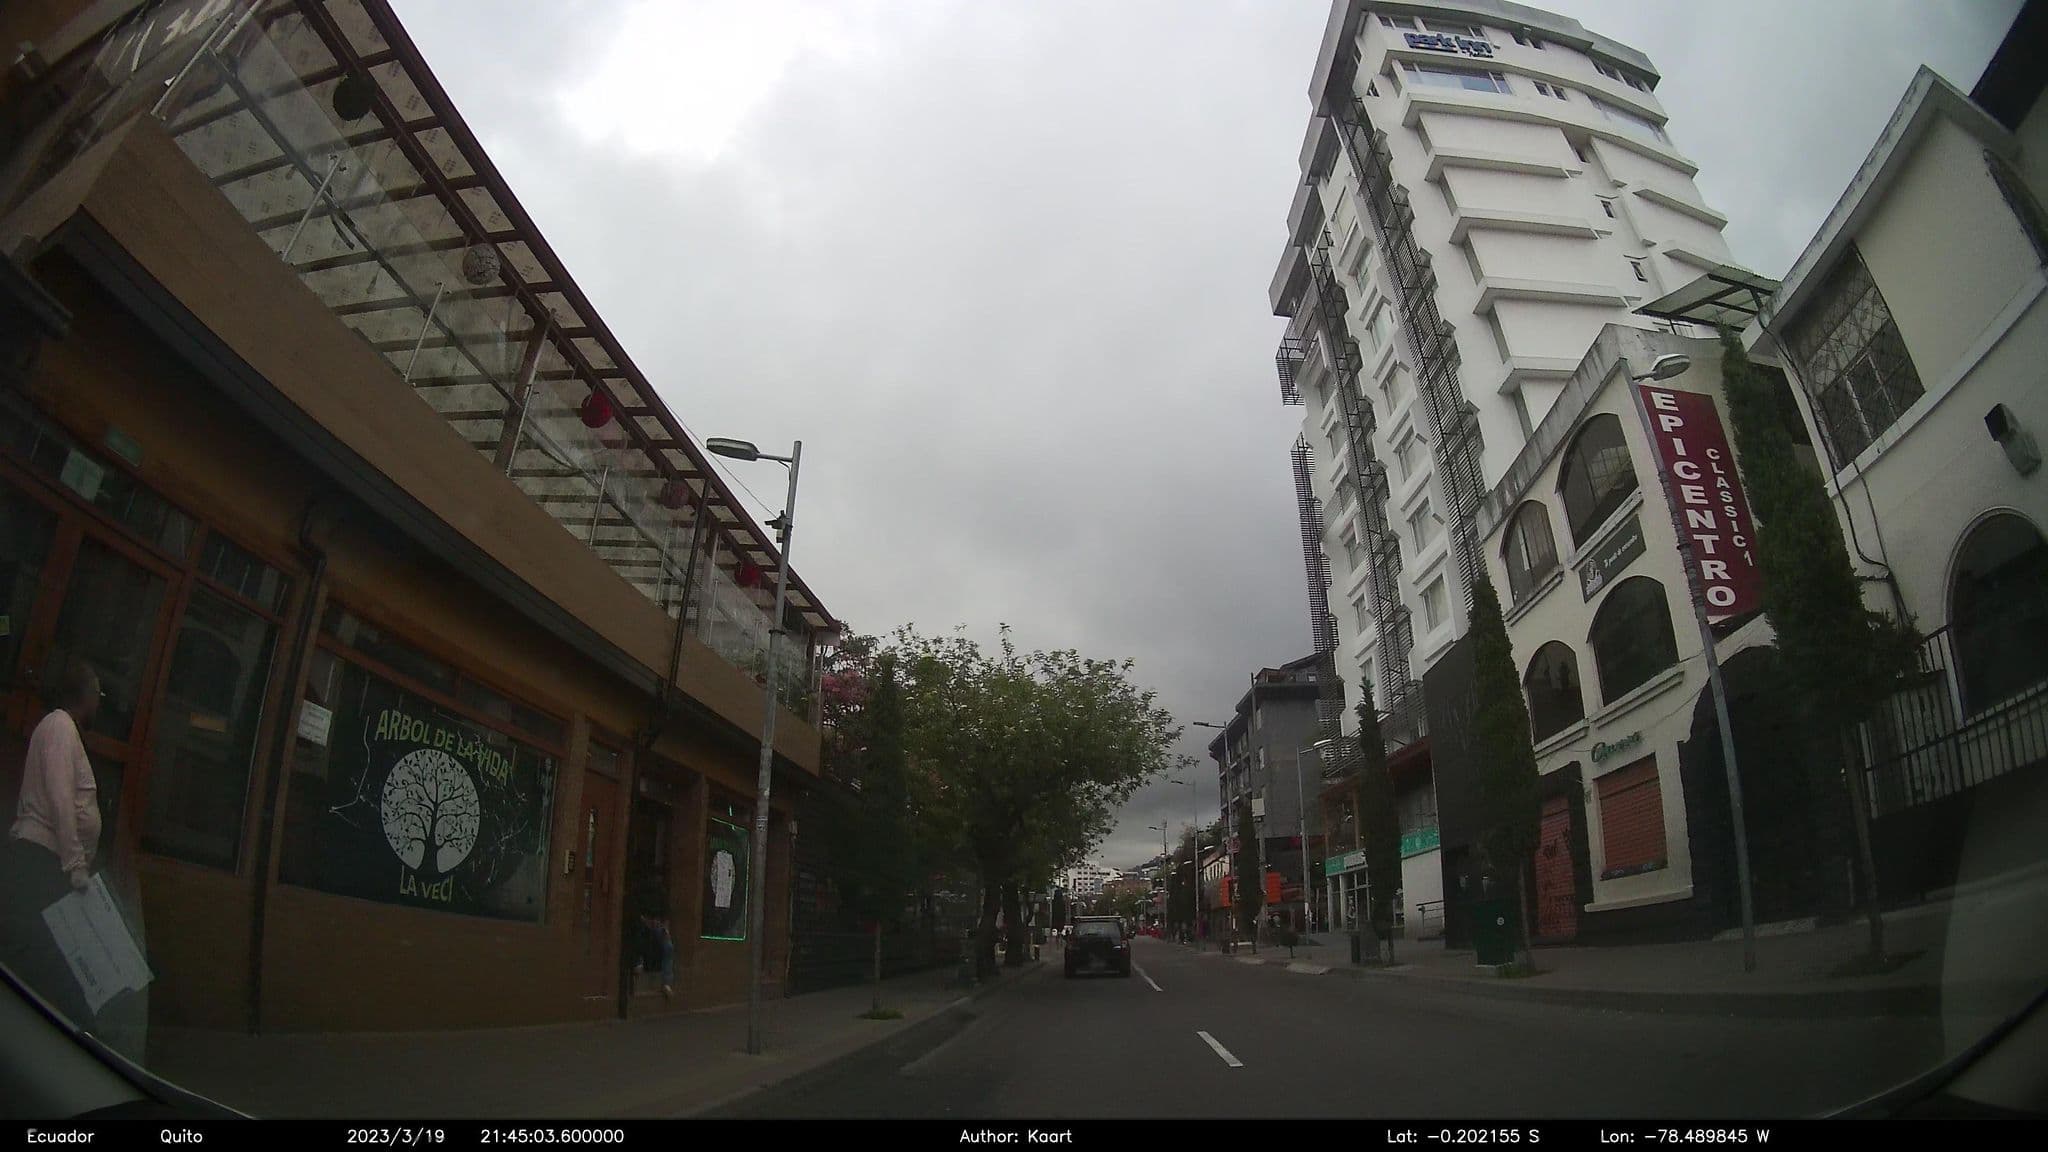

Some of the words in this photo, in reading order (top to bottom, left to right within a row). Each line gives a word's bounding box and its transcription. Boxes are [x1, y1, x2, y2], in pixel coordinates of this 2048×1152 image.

[1650, 391, 1737, 608] EPICENTRO
[1705, 448, 1748, 549] CLASSIC
[1744, 550, 1755, 567] 1
[373, 709, 431, 745] ARBOL
[434, 728, 455, 751] DE
[456, 741, 474, 762] LA
[399, 865, 418, 897] LA
[421, 874, 454, 904] VECI
